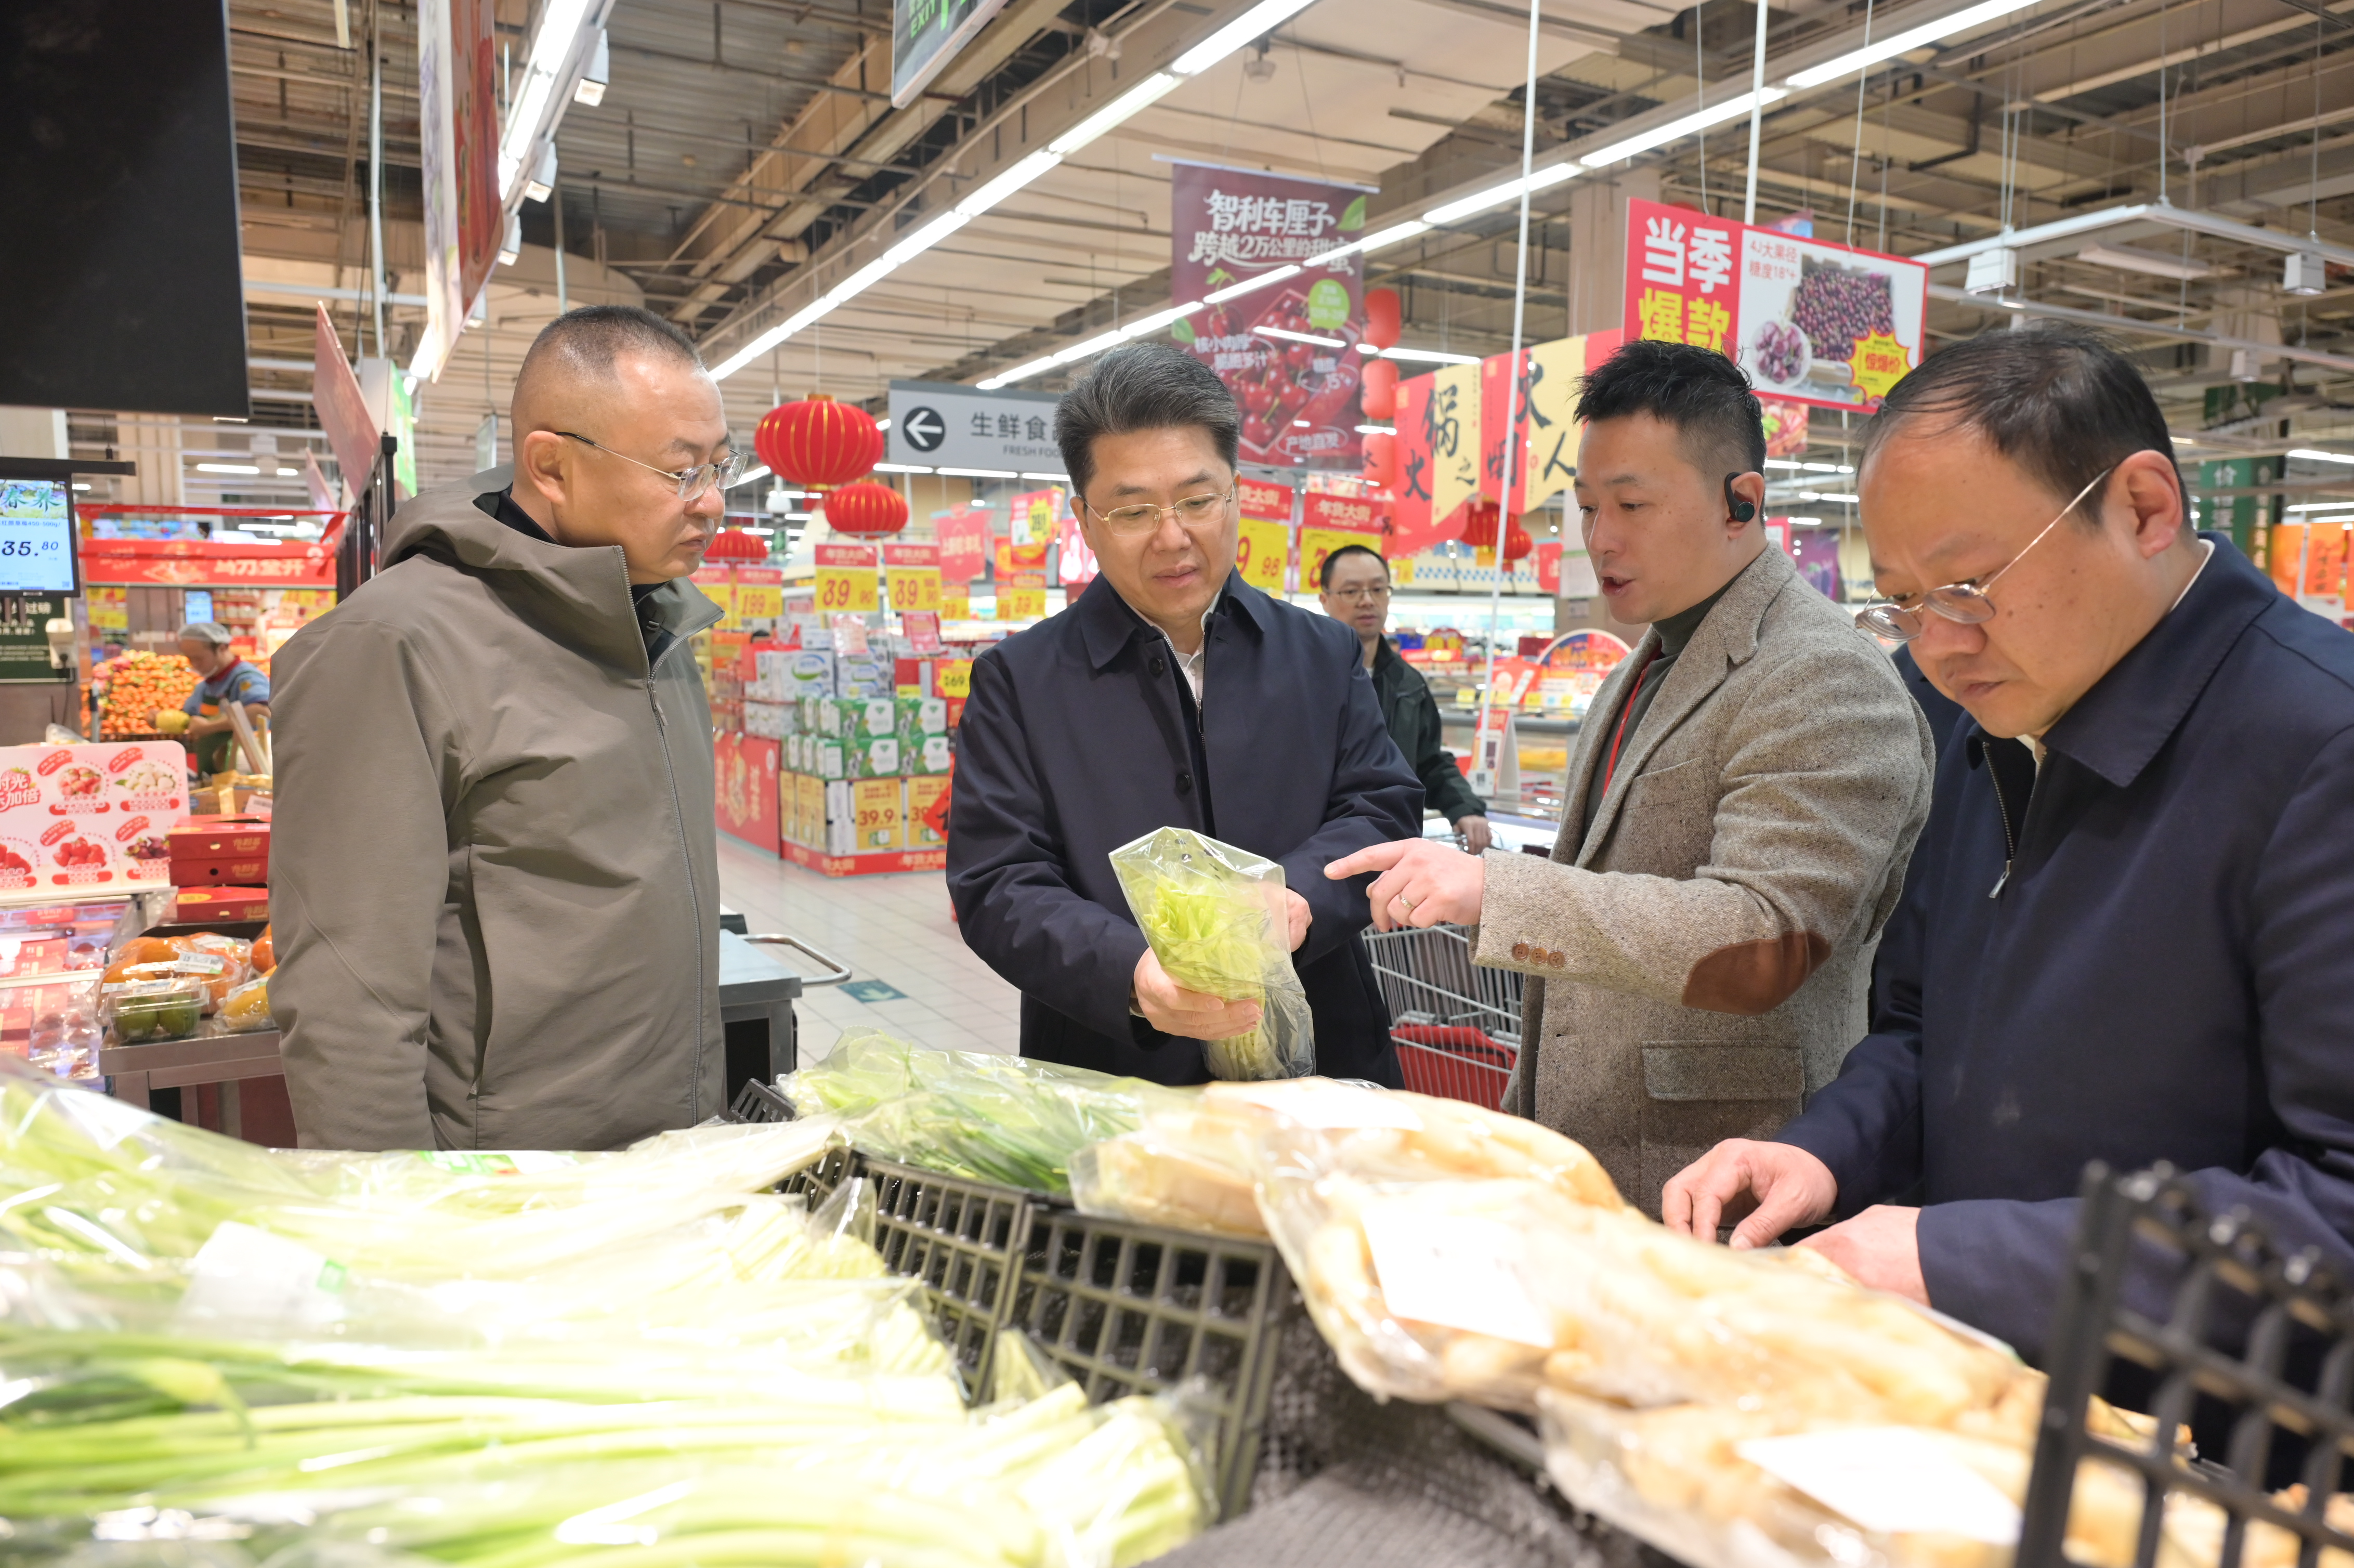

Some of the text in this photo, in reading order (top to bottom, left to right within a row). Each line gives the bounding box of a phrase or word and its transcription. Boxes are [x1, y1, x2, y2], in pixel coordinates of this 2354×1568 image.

[910, 0, 935, 38] EXIT
[1203, 189, 1337, 237] 智利车厘子
[1642, 217, 1733, 294] 当季
[1638, 287, 1730, 355] 爆款
[971, 411, 1058, 441] 生鲜食
[1003, 445, 1061, 458] FRESH FOO
[823, 578, 851, 607] 39
[895, 579, 918, 606] 39
[859, 808, 895, 826] 39.9
